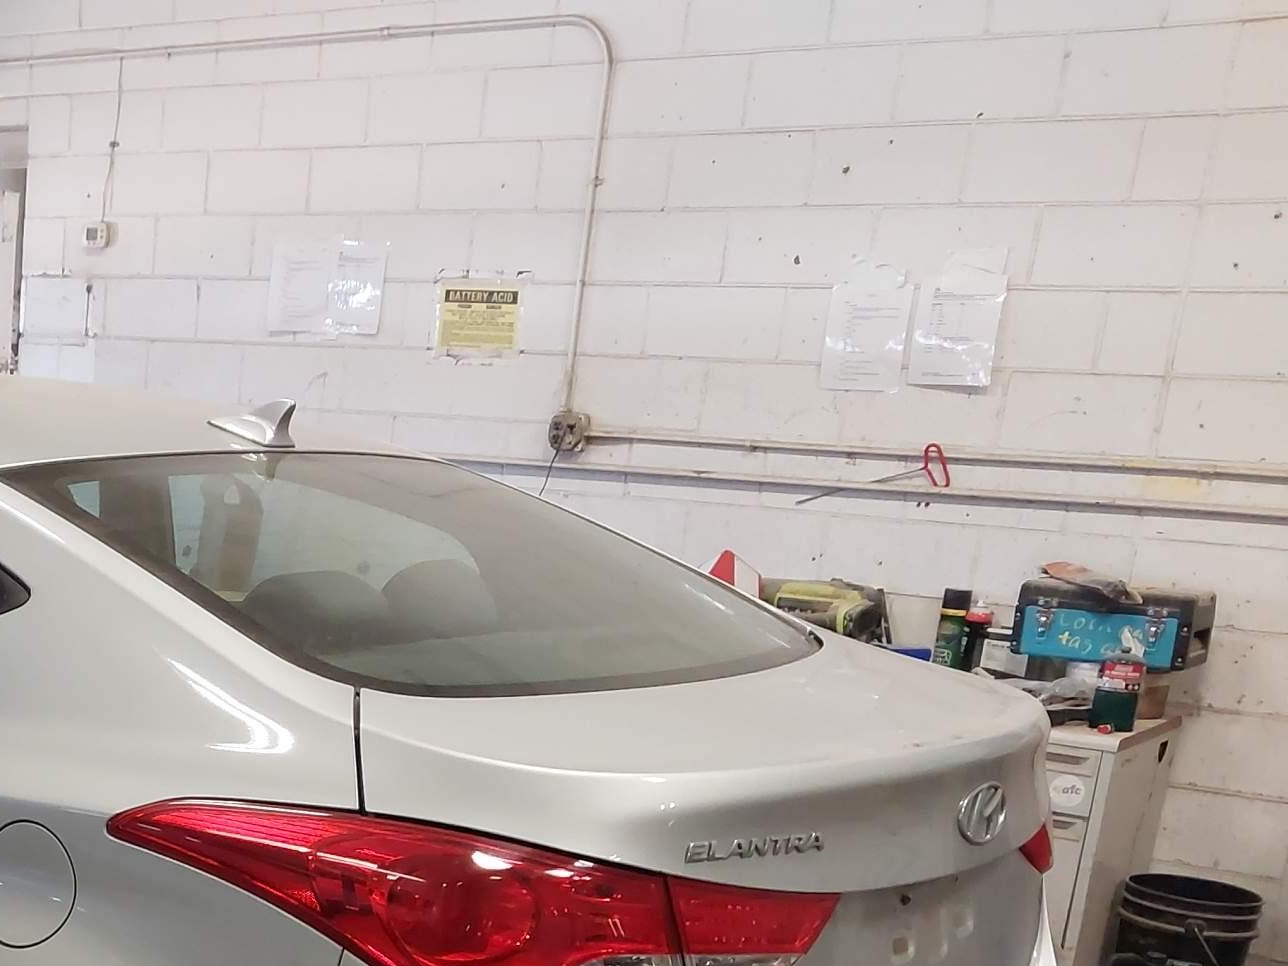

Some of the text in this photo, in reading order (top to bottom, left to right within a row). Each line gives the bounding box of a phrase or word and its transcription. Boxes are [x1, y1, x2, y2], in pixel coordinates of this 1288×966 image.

[448, 290, 514, 303] BATTERY ACID
[684, 832, 825, 864] ELANTRA
